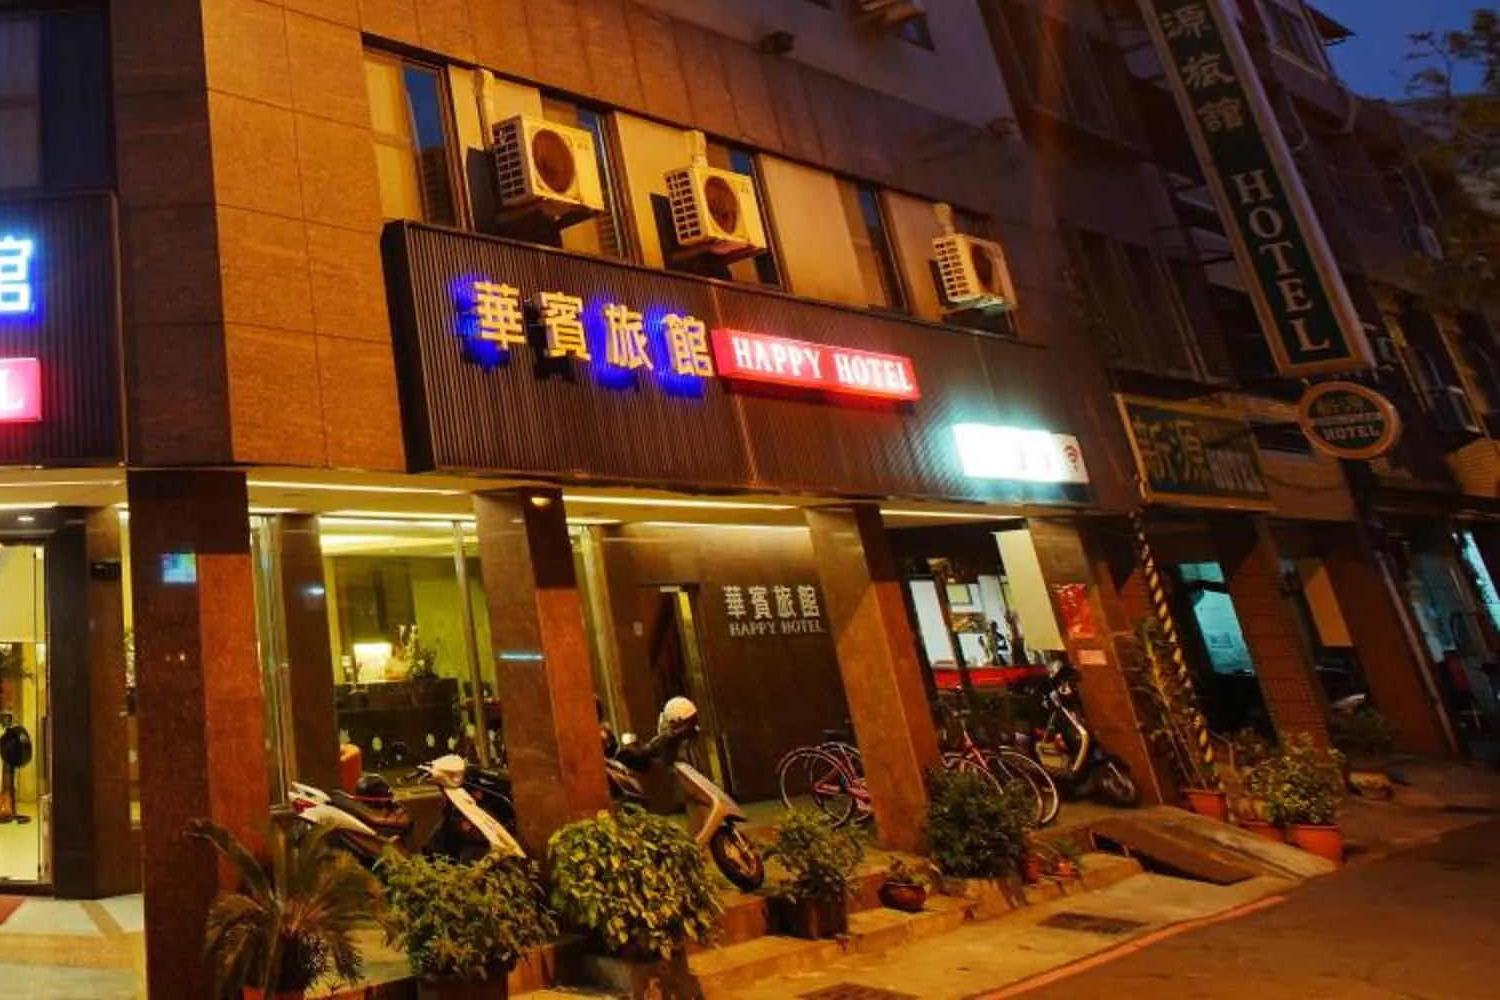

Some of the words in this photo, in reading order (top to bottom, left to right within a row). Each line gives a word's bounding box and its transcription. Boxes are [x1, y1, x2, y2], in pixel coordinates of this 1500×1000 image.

[1230, 168, 1332, 352] HOTEL
[473, 280, 714, 377] 華賓旅館
[732, 335, 822, 380] HAPPY
[835, 353, 913, 392] HOTEL
[721, 584, 820, 619] 華賓旅館
[729, 620, 776, 636] HAPPY
[781, 619, 825, 634] HOTEL
